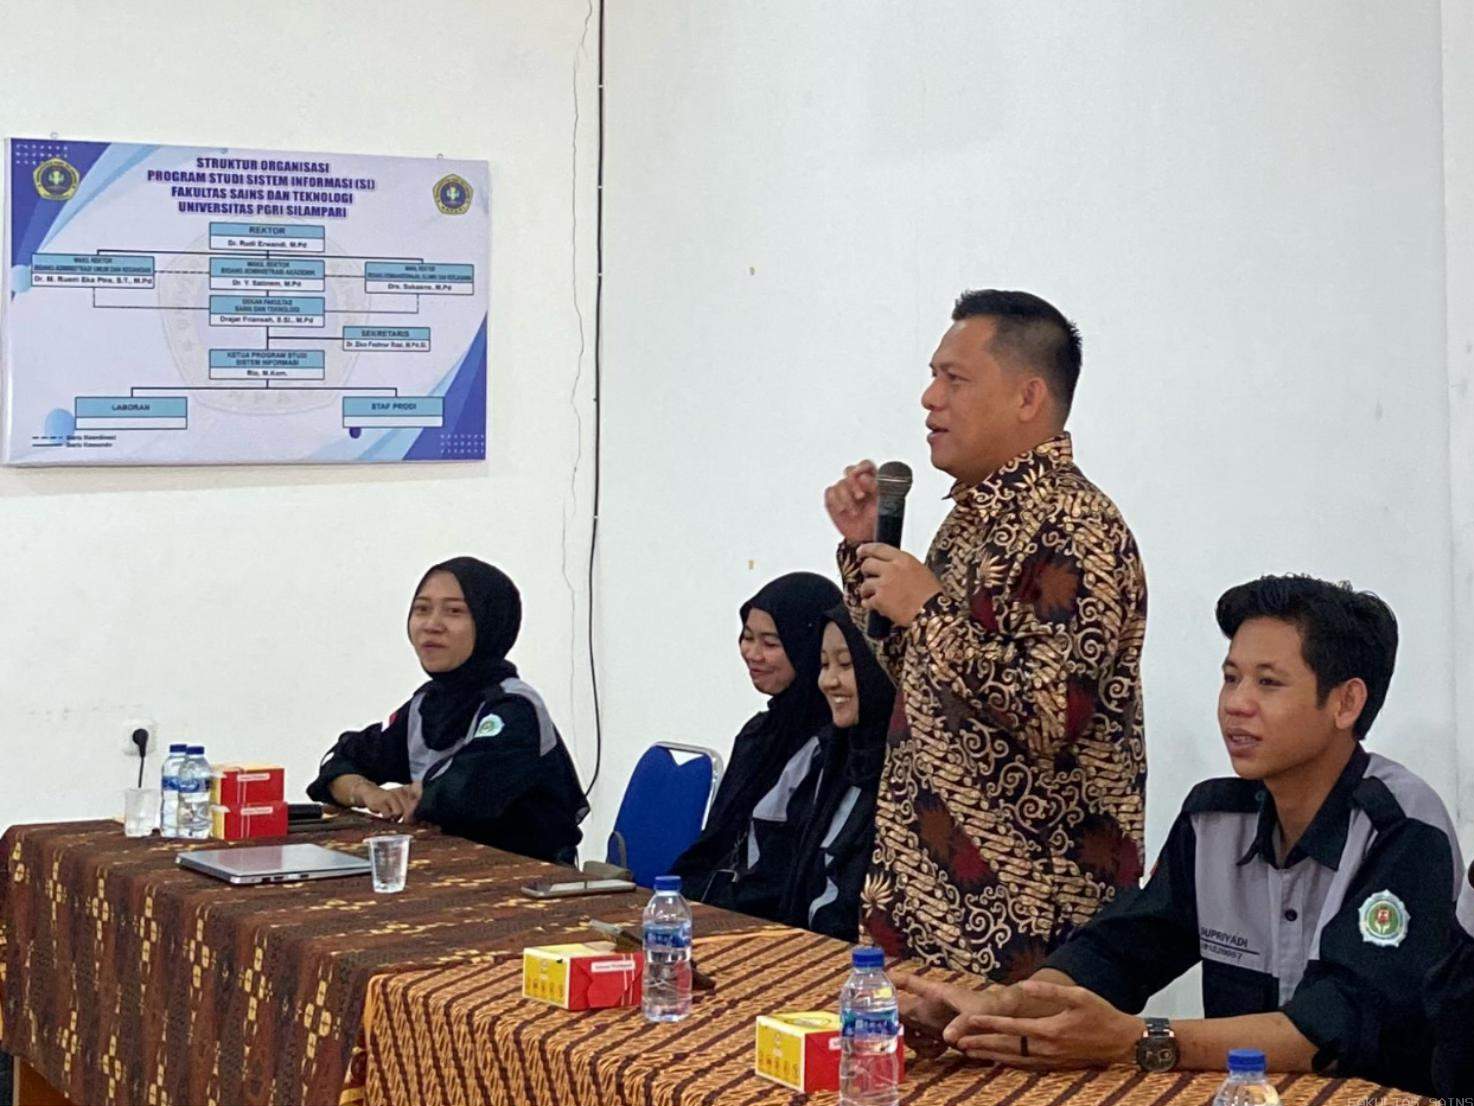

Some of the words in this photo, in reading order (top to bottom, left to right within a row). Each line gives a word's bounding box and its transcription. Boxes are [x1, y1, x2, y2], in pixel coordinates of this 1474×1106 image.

[196, 157, 258, 170] STRUKTUR
[260, 160, 330, 174] ORGANISASI
[147, 170, 206, 182] PROGRAM
[209, 172, 244, 184] STUDI
[246, 174, 289, 187] SISTEM
[290, 176, 353, 189] INFORMASI
[355, 178, 376, 190] (SI)
[171, 186, 227, 199] FAKULTAS
[229, 188, 265, 200] SAINS
[267, 190, 290, 201] DAN
[292, 191, 353, 204] TEKNOLOGI
[178, 201, 254, 214] UNIVERSITAS
[256, 204, 284, 216] PGRI
[286, 205, 347, 218] SILAMPARI
[248, 226, 287, 235] REKTOR
[361, 329, 410, 338] SEKRETARIS
[111, 403, 151, 411] LABORAN
[371, 402, 391, 410] STAF
[392, 402, 417, 410] PRODI
